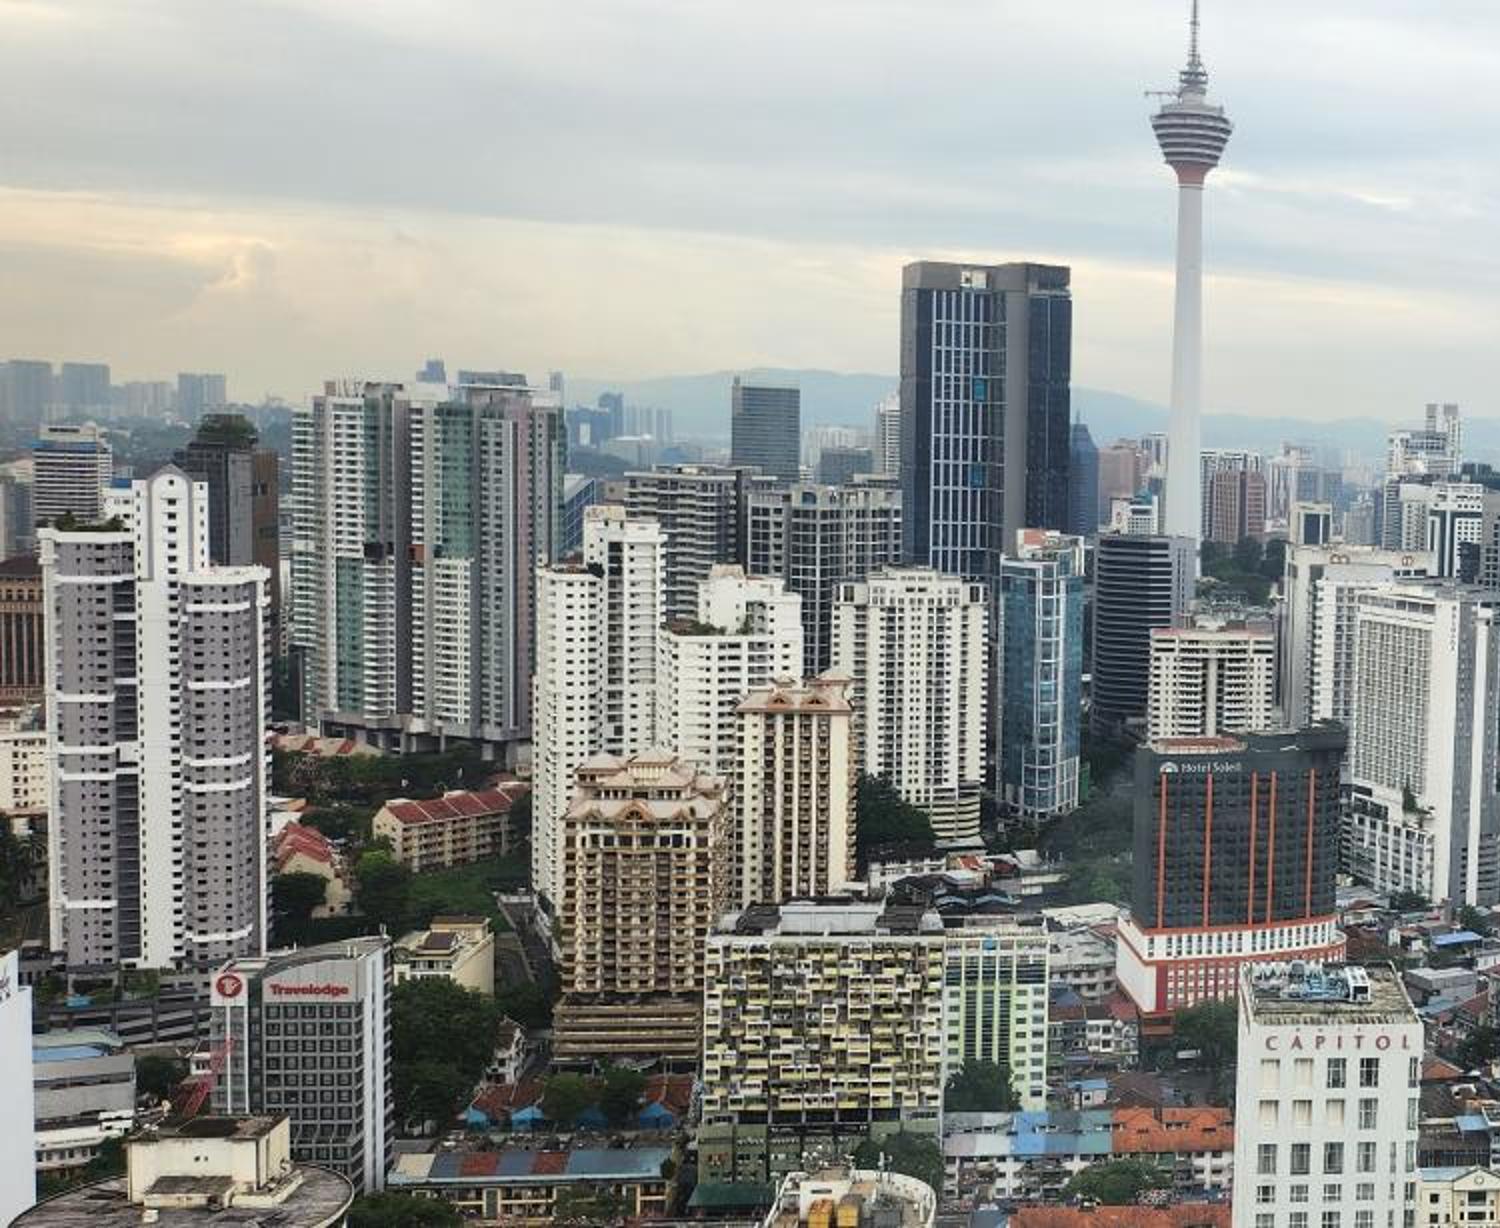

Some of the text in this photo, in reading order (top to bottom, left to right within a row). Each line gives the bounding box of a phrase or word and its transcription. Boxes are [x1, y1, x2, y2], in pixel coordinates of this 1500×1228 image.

[1181, 763, 1211, 774] Hotel
[269, 983, 349, 997] Travelodge
[1265, 1034, 1410, 1051] CAPITOL
